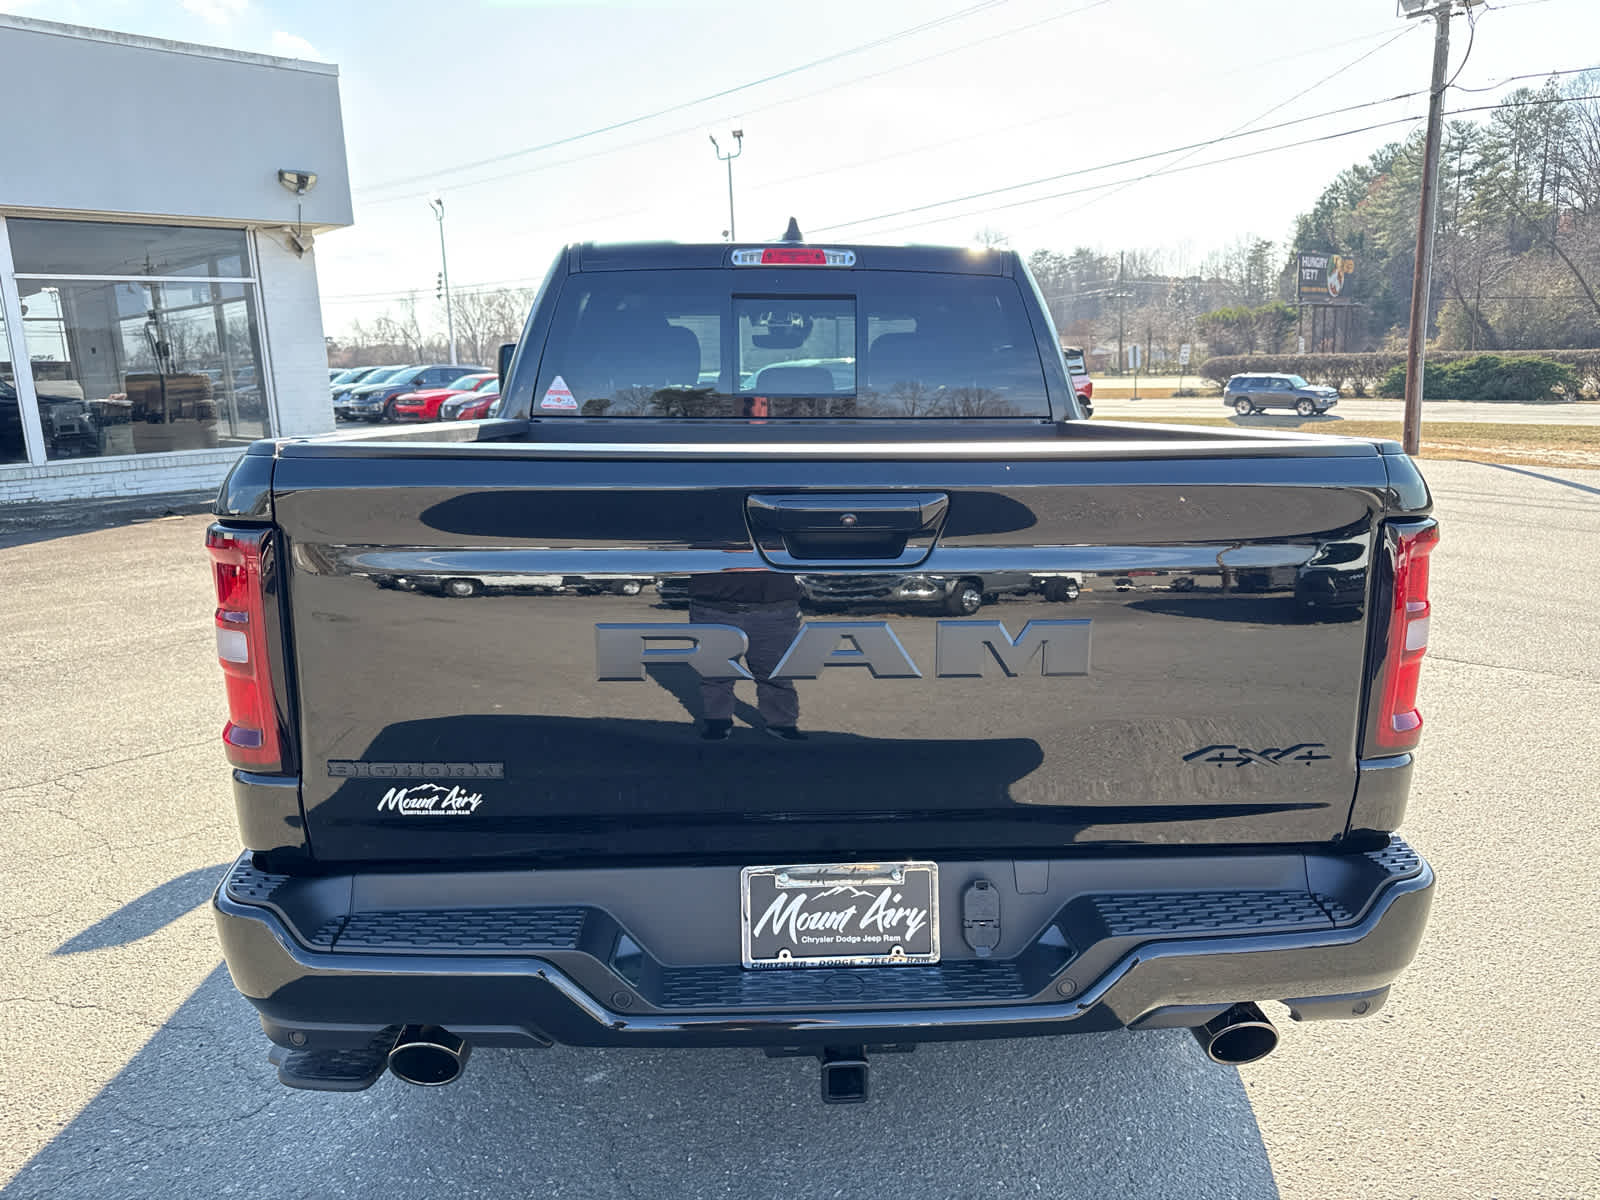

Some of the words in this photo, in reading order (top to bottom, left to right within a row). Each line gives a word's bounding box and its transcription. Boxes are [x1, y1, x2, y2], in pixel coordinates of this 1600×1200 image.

[1302, 255, 1329, 269] HUNGRY
[595, 618, 1093, 682] RAM
[377, 787, 440, 816] Mount
[441, 785, 483, 812] Airy
[753, 892, 858, 944] Mount
[859, 887, 927, 941] Airy
[801, 935, 835, 945] Chrysler
[836, 935, 861, 944] Dodge
[863, 934, 882, 944] Jeep
[883, 934, 901, 942] Ram
[751, 960, 807, 969] CHRYSLER
[818, 959, 856, 967] DODGE
[869, 957, 895, 966] JEEP
